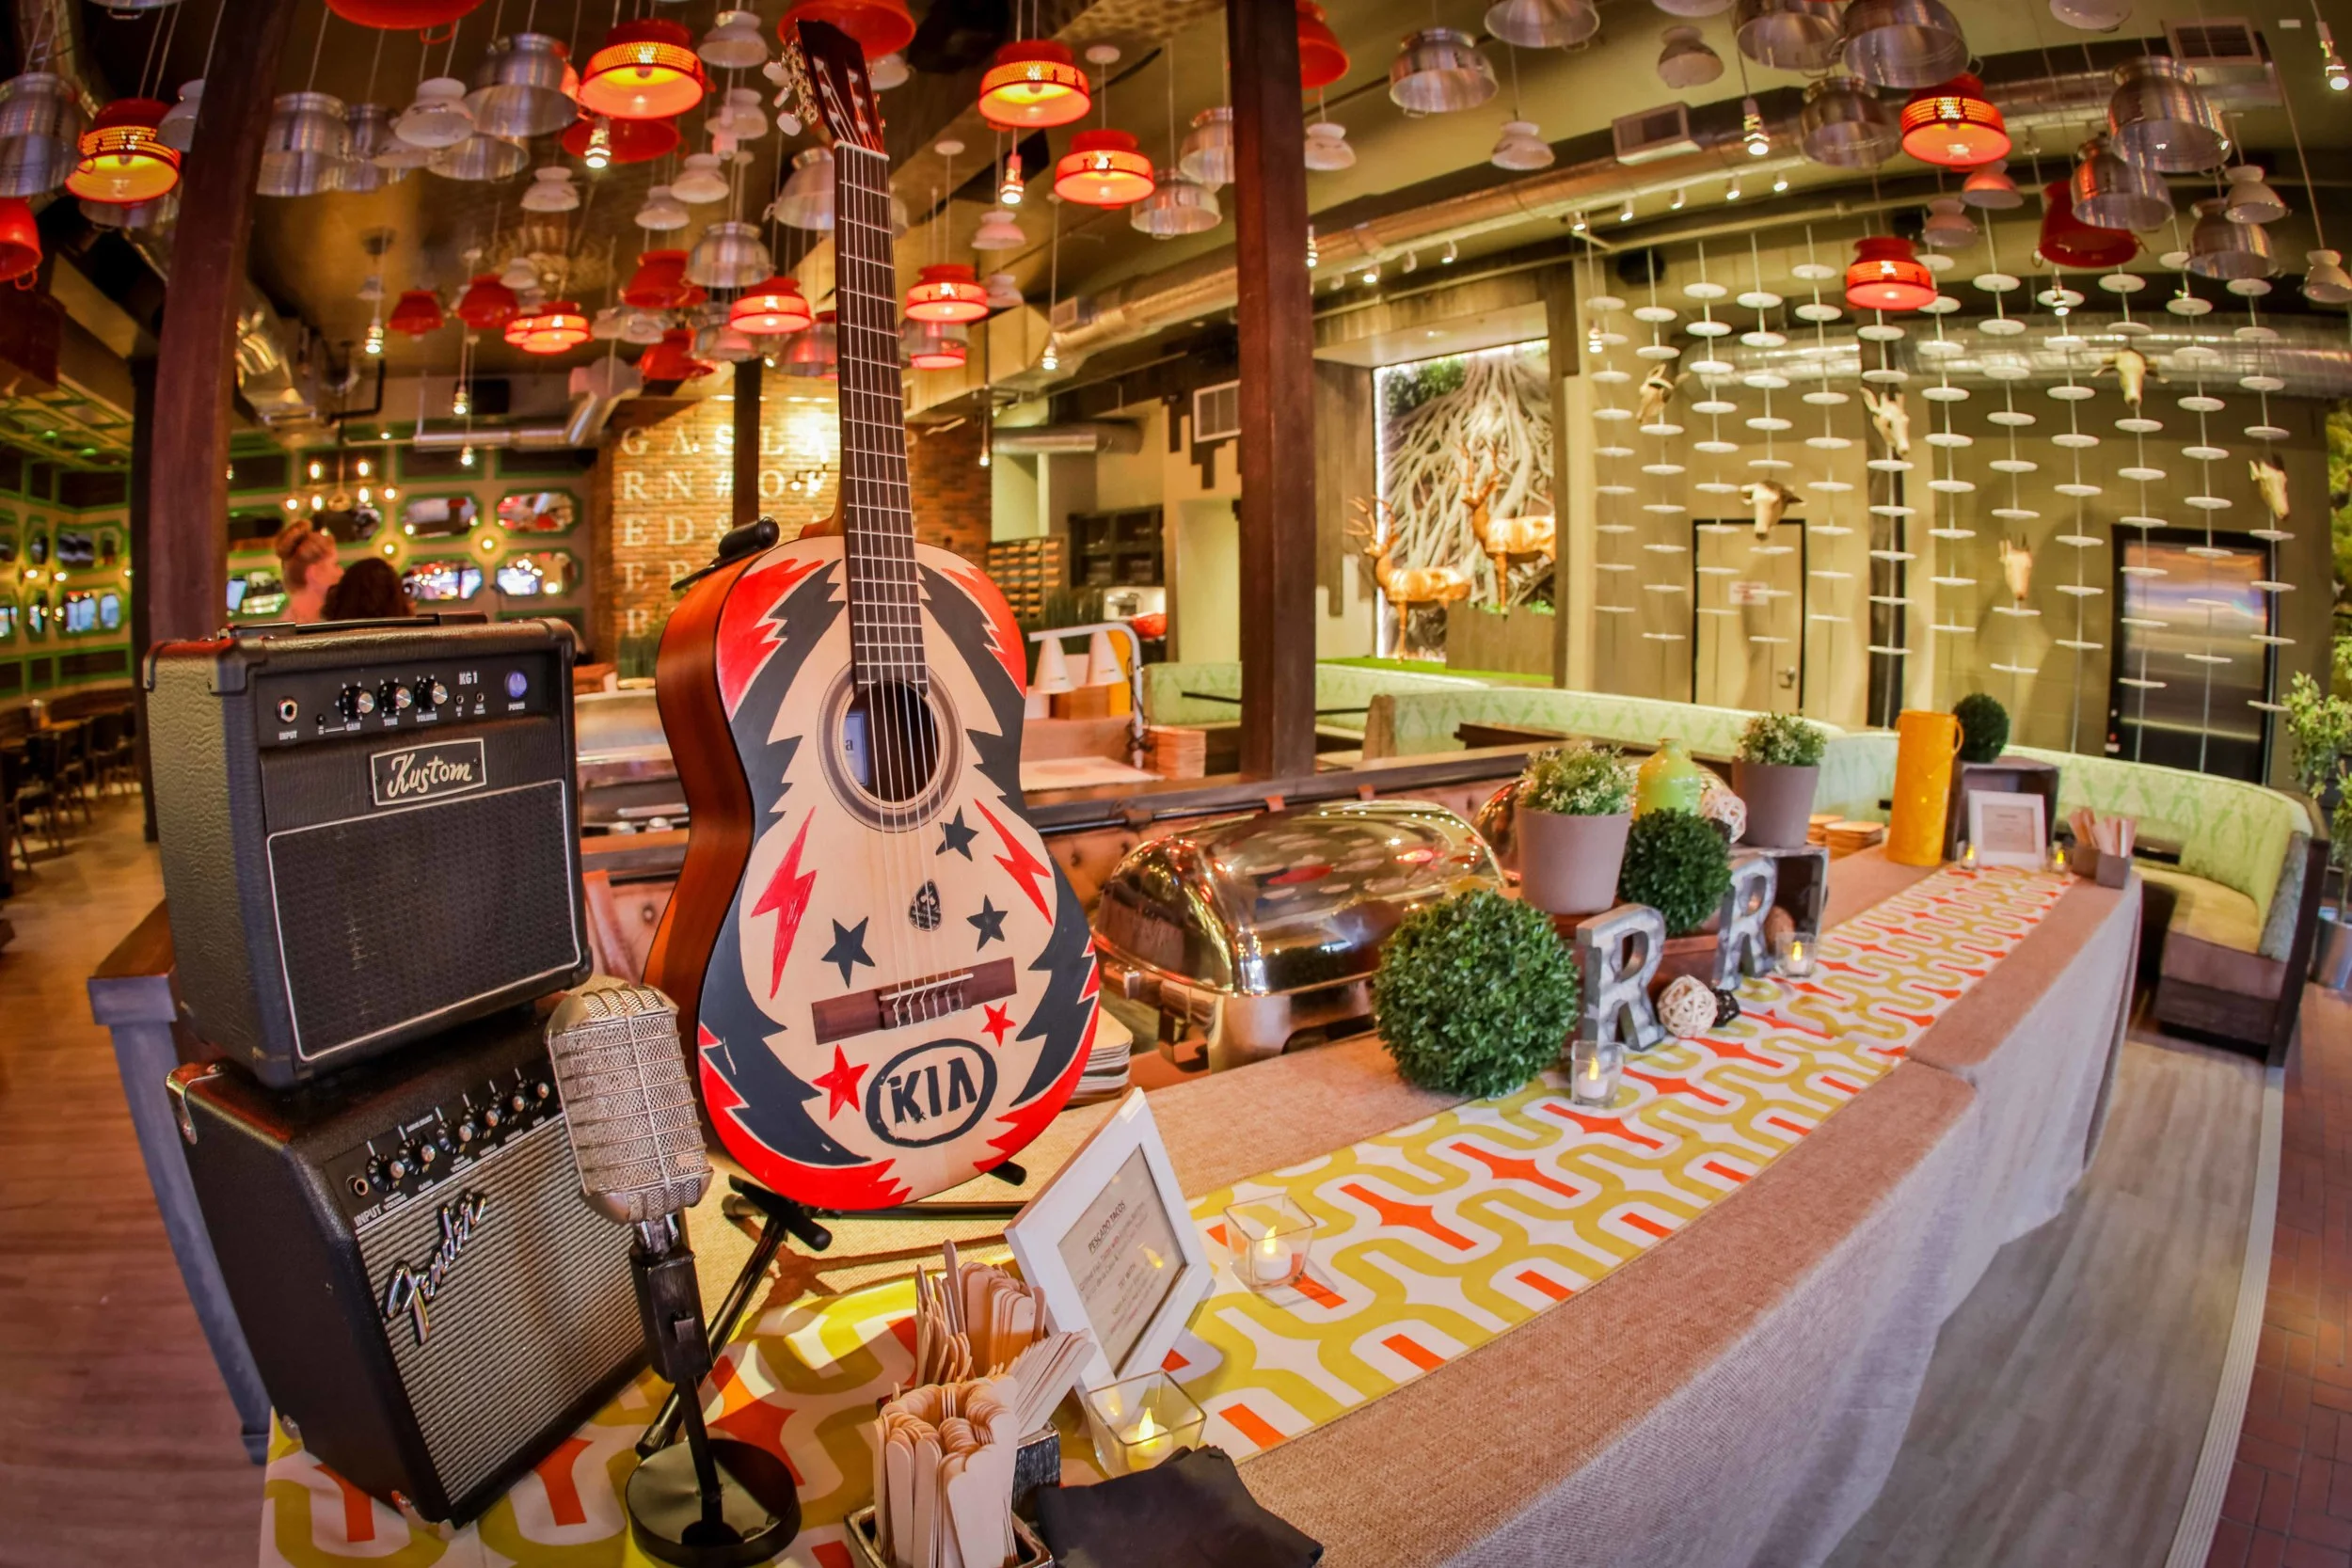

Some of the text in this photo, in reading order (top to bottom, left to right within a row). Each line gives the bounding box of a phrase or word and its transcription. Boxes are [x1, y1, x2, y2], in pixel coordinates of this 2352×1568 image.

[387, 752, 472, 799] Kustom
[1577, 902, 1667, 1053] R
[887, 1057, 977, 1124] KIA
[354, 1204, 382, 1227] INPUT
[1088, 1200, 1126, 1252] PESCADO TACOS
[386, 1192, 487, 1345] Fender
